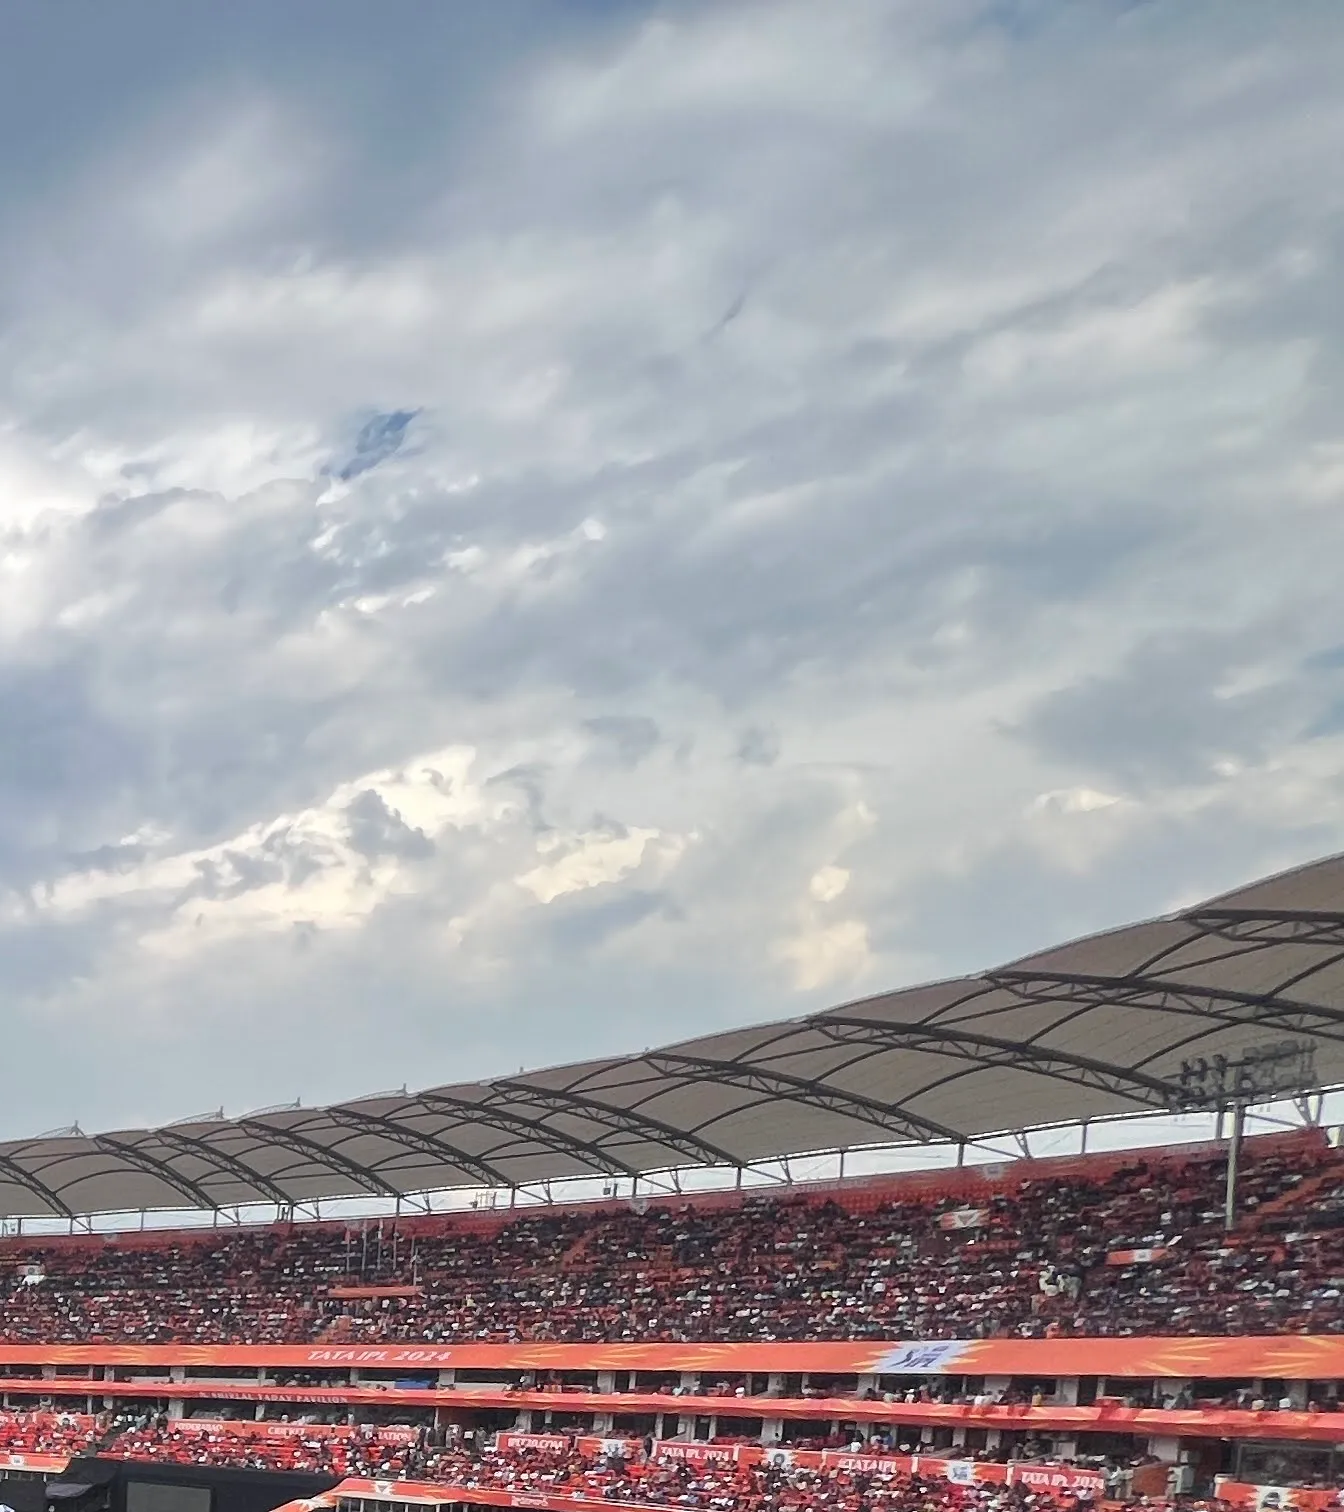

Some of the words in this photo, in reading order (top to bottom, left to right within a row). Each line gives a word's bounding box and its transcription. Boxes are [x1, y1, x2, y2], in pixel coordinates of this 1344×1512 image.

[307, 1351, 356, 1360] TATA
[356, 1351, 389, 1360] IPL
[392, 1351, 452, 1360] 2024
[659, 1446, 682, 1459] TATA
[683, 1448, 700, 1460] IPL
[701, 1450, 729, 1462] 2024
[836, 1459, 896, 1474] #TATAIPL
[1020, 1471, 1051, 1487] TATA
[1050, 1473, 1070, 1488] IPL
[1072, 1475, 1106, 1491] 2024
